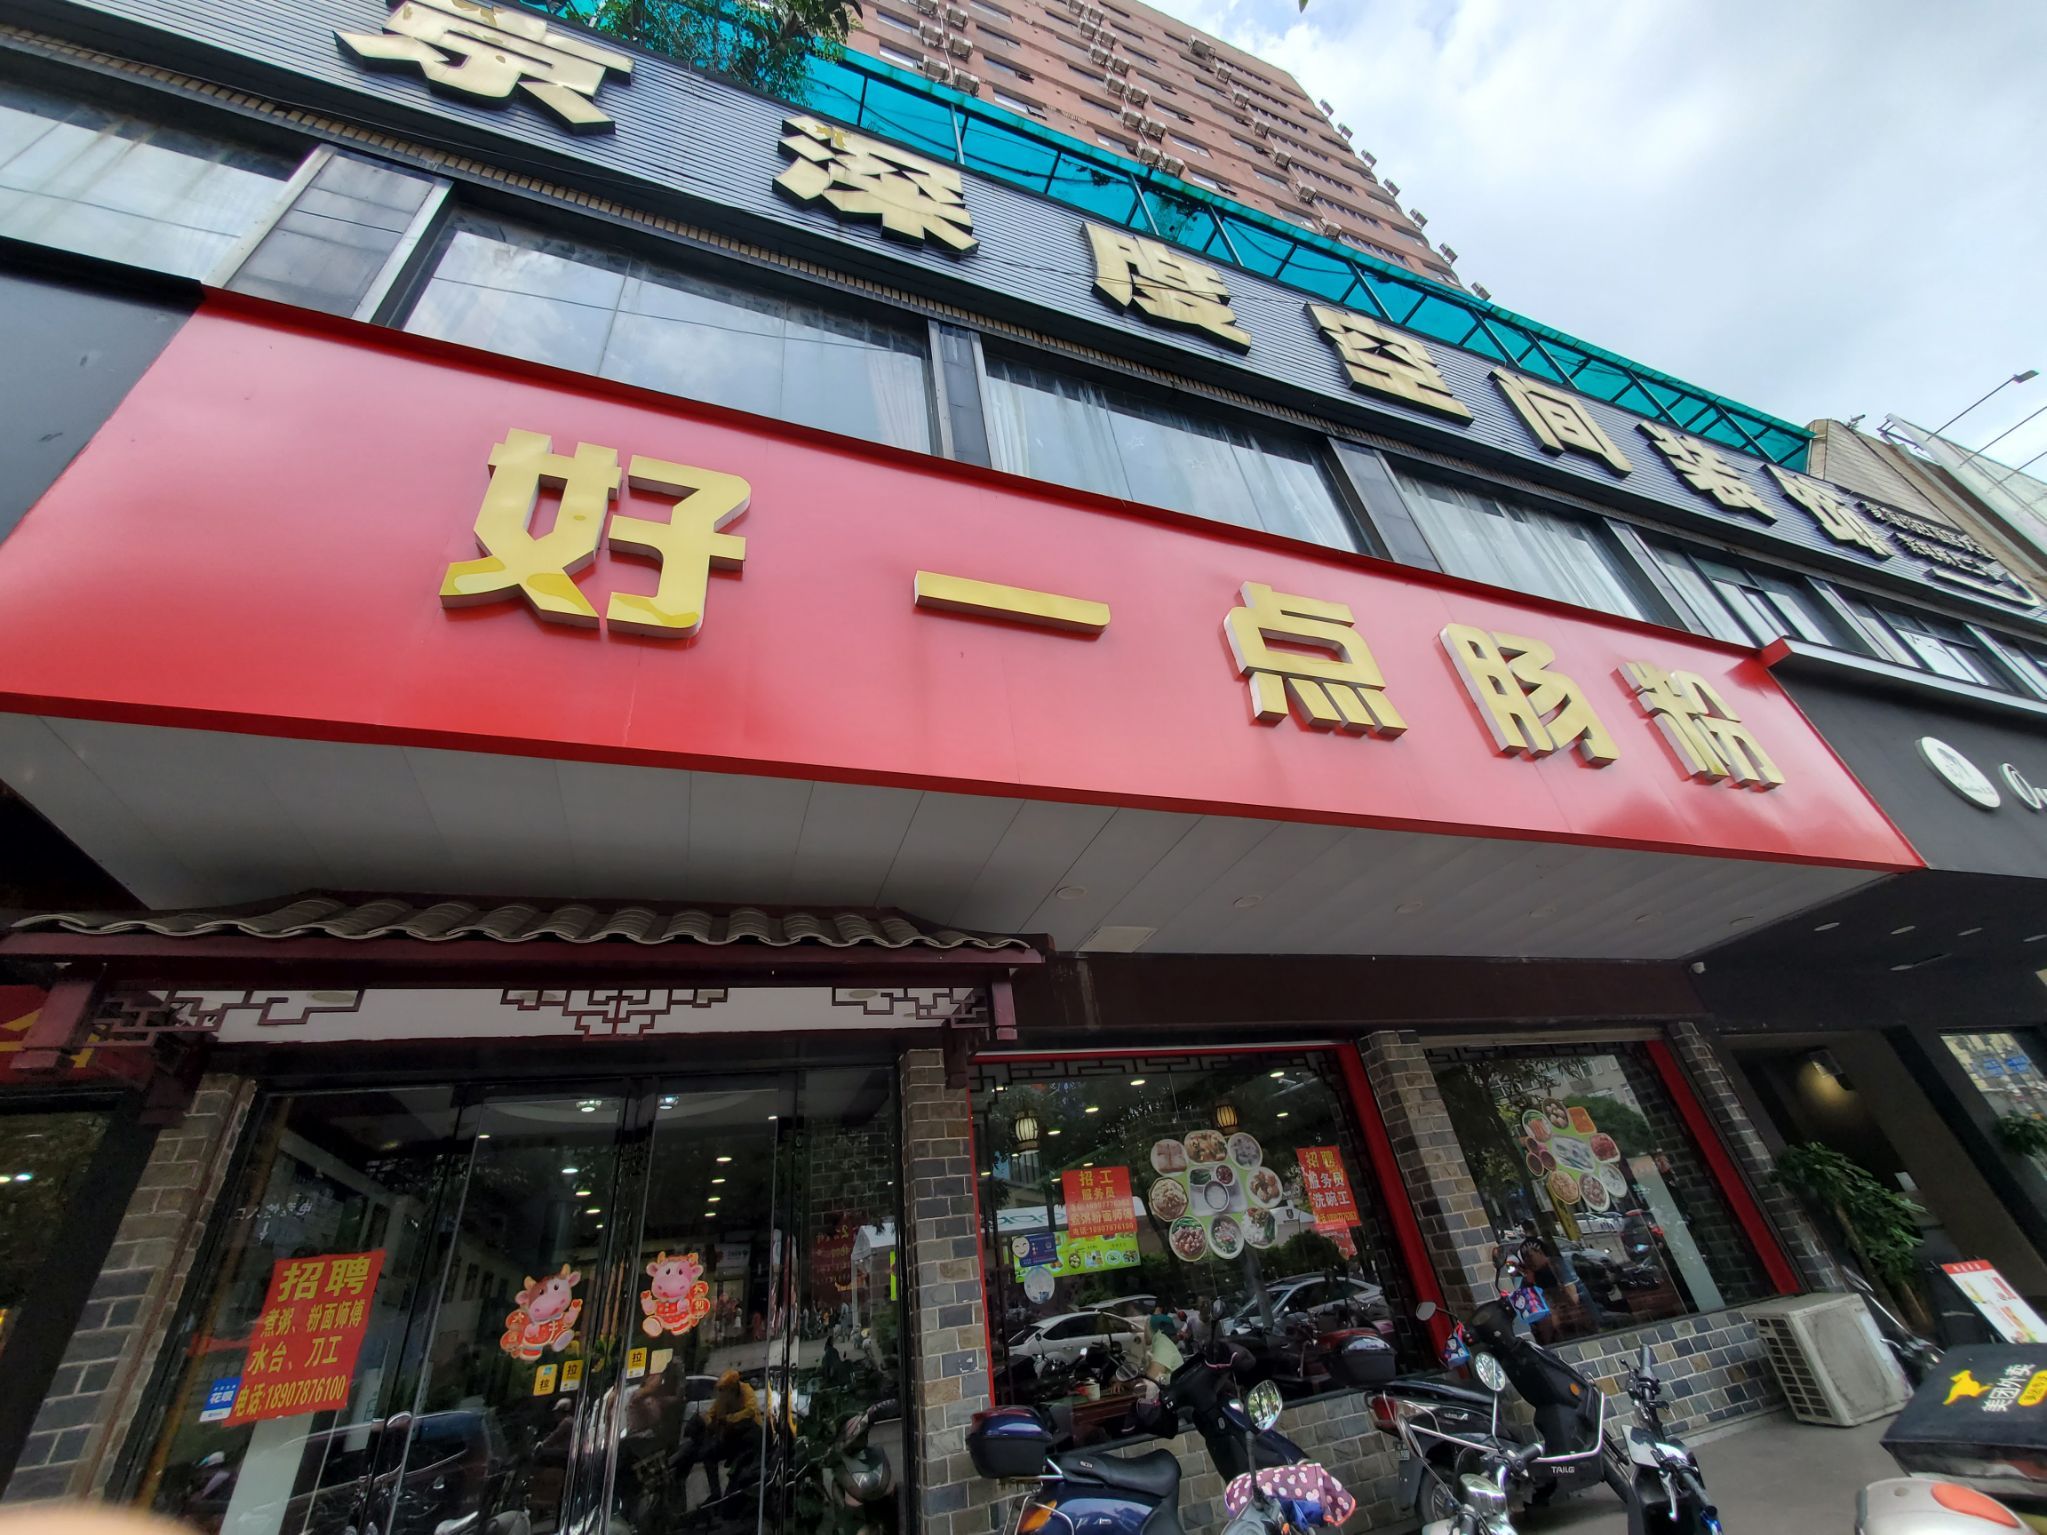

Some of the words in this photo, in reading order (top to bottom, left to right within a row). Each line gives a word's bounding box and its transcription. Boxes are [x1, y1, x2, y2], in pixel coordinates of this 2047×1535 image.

[439, 428, 1785, 790] 好一点肠粉
[1304, 1150, 1337, 1169] 招聘
[1078, 1169, 1114, 1186] 招工
[1307, 1170, 1345, 1189] 服务员
[1081, 1186, 1115, 1201] 服务员
[1313, 1190, 1351, 1208] 洗碗工
[277, 1256, 372, 1302] 招聘
[234, 1375, 347, 1417] 电话:18907876100
[1981, 1363, 2037, 1413] 美团外卖
